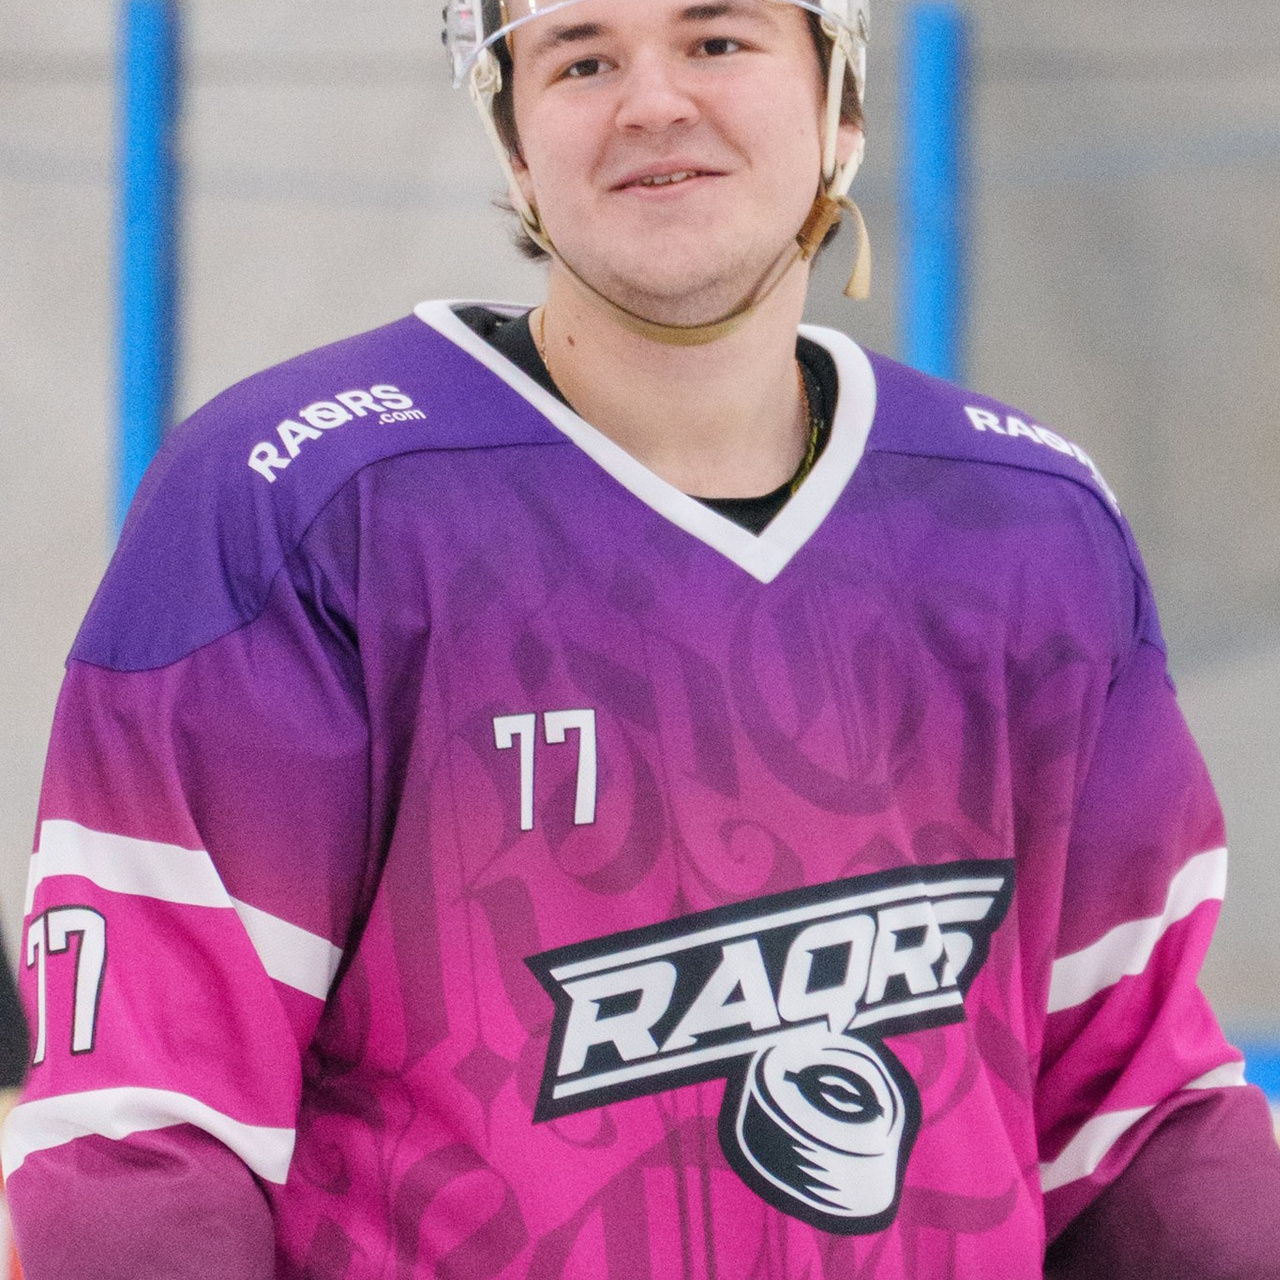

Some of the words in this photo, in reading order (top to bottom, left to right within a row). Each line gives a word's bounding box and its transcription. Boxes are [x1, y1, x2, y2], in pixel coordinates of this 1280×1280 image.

[378, 408, 427, 426] .com
[493, 709, 597, 831] 77
[26, 904, 106, 1067] 77
